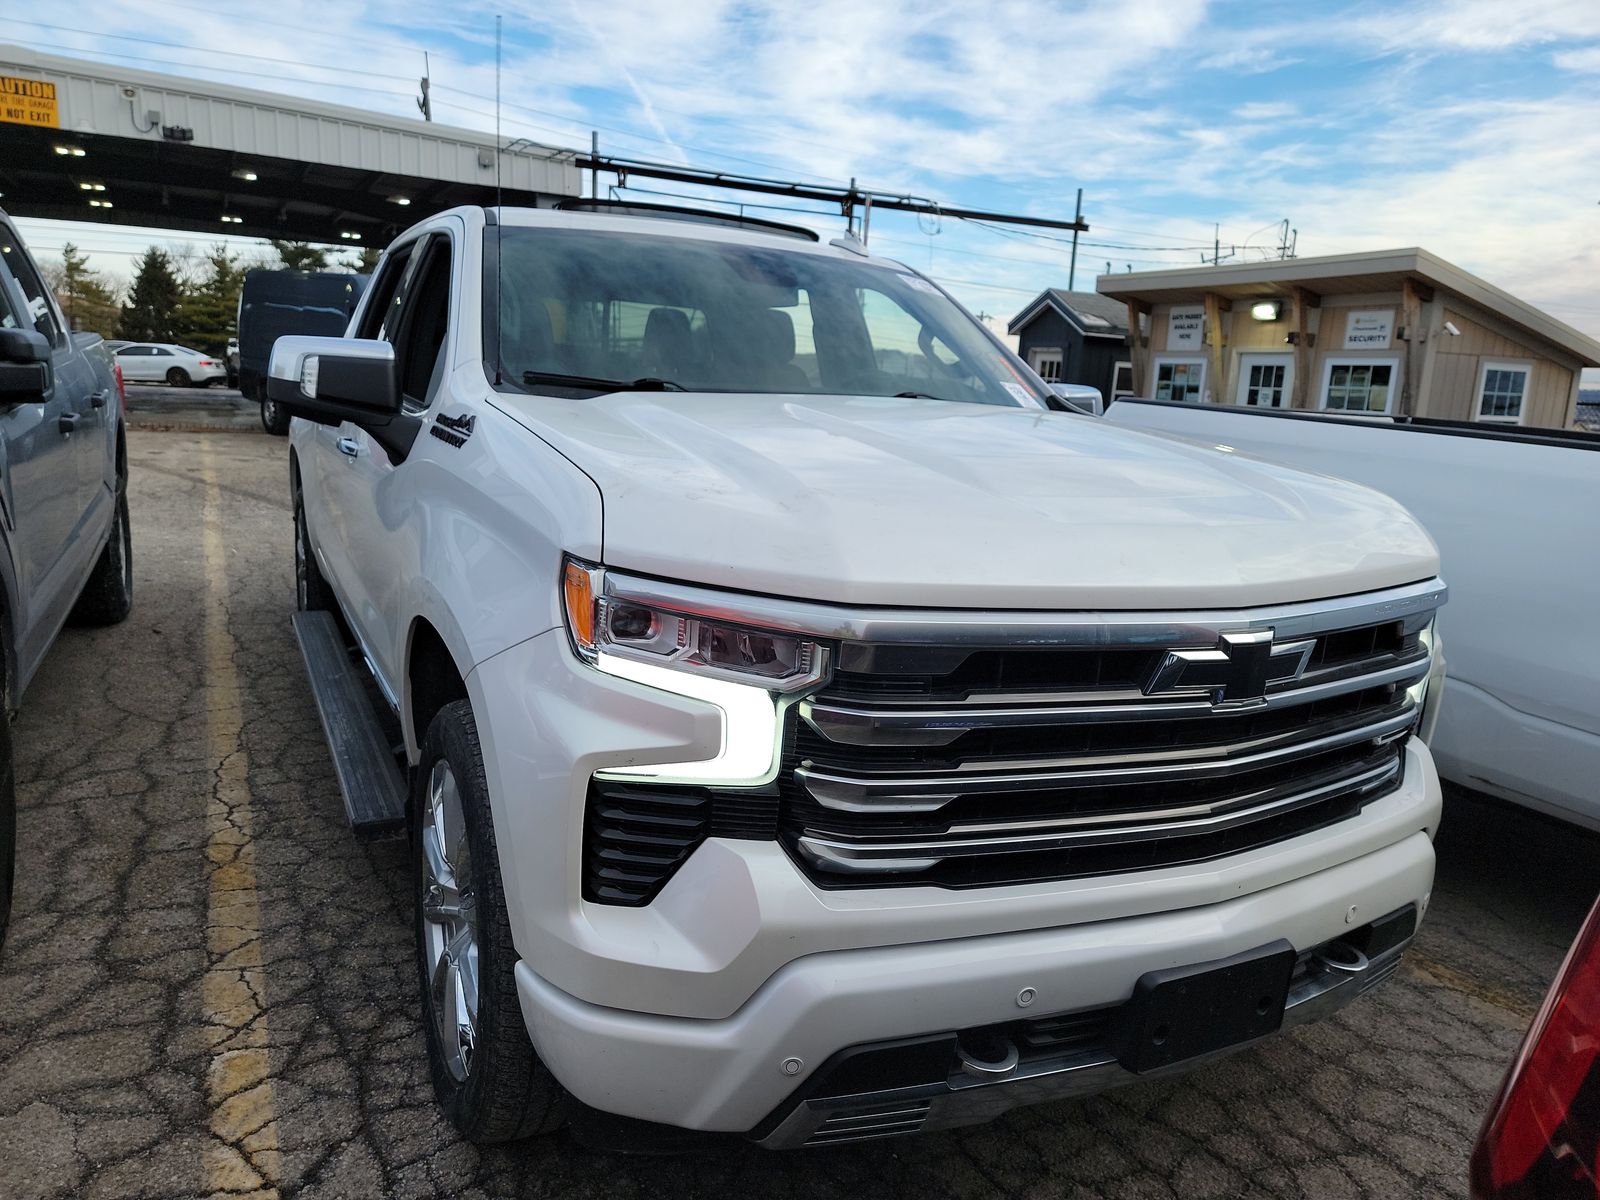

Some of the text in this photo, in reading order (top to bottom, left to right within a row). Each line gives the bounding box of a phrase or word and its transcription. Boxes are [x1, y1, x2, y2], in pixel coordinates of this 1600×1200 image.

[29, 99, 54, 110] DAMAGE
[7, 107, 25, 119] NOT
[30, 110, 50, 123] EXIT
